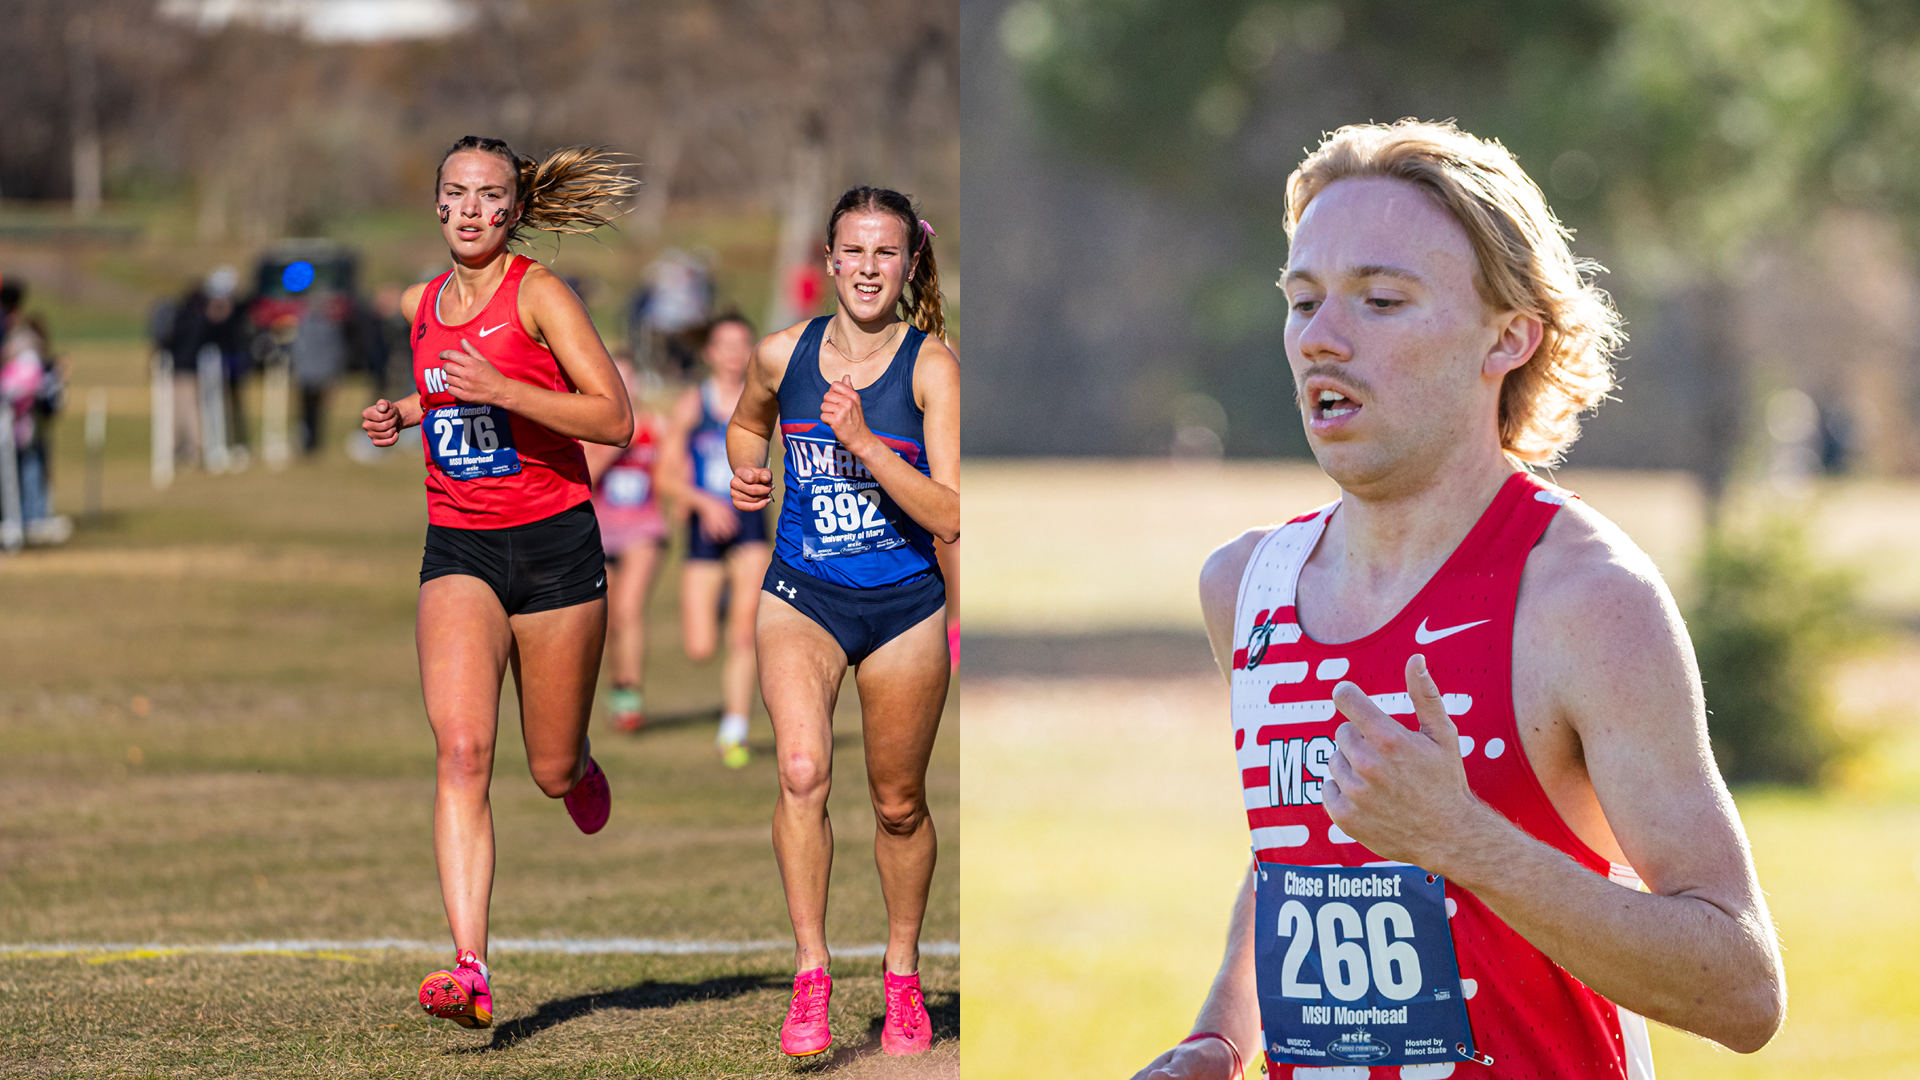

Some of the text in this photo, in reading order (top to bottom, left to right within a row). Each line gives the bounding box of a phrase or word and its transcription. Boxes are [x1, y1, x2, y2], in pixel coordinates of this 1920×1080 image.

[434, 405, 492, 419] Katelyn Kennedy
[434, 416, 499, 457] 276
[449, 454, 494, 466] MSU Moorhead
[791, 440, 872, 479] UMAR
[811, 484, 833, 494] Terez
[812, 489, 887, 534] 392
[822, 528, 885, 544] University of Mary
[1269, 736, 1337, 807] MS
[1284, 871, 1402, 897] Chase Hoechst
[1277, 899, 1422, 1002] 266
[1302, 1005, 1408, 1025] MSU Moorhead
[1404, 1047, 1447, 1056] Minot State
[1405, 1038, 1444, 1047] Hosted by
